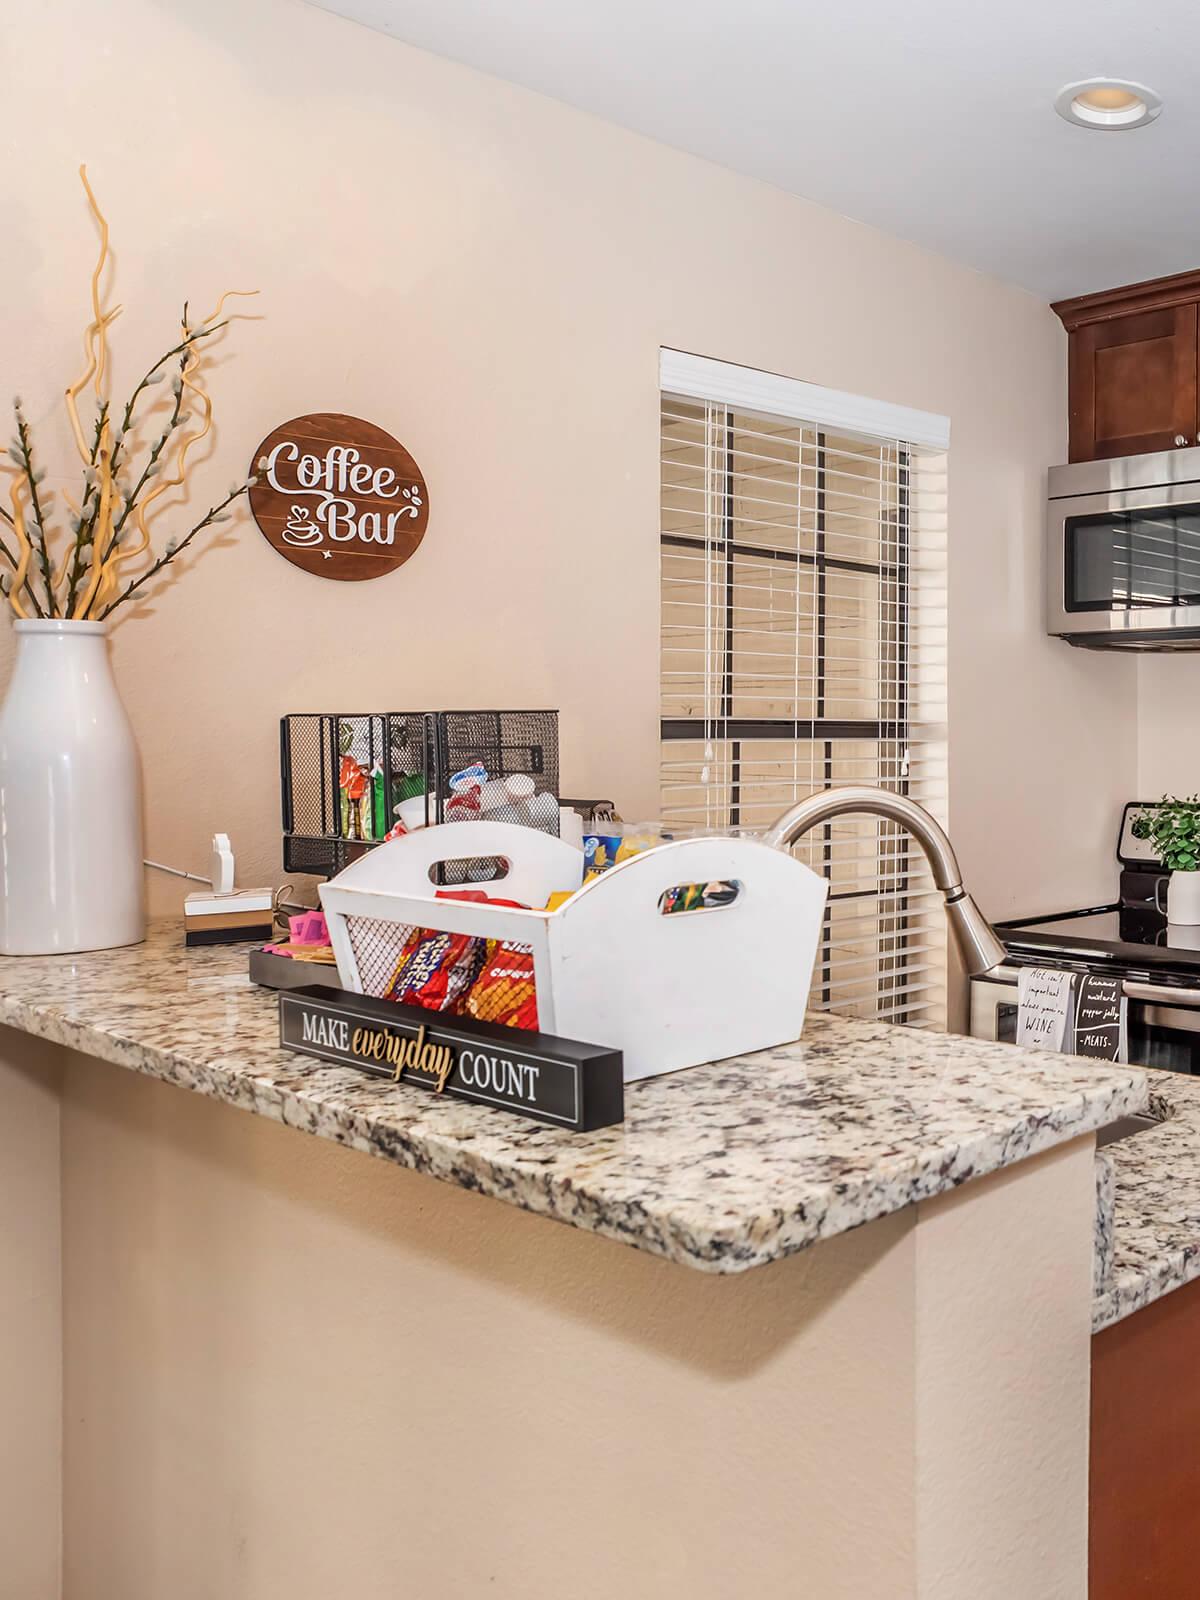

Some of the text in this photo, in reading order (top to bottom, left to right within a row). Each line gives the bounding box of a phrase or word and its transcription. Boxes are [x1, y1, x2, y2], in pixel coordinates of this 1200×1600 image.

[266, 442, 399, 499] Coffee
[316, 498, 418, 544] Bar
[1025, 1016, 1055, 1034] WINE
[302, 1012, 540, 1101] MAKE everyday COUNT
